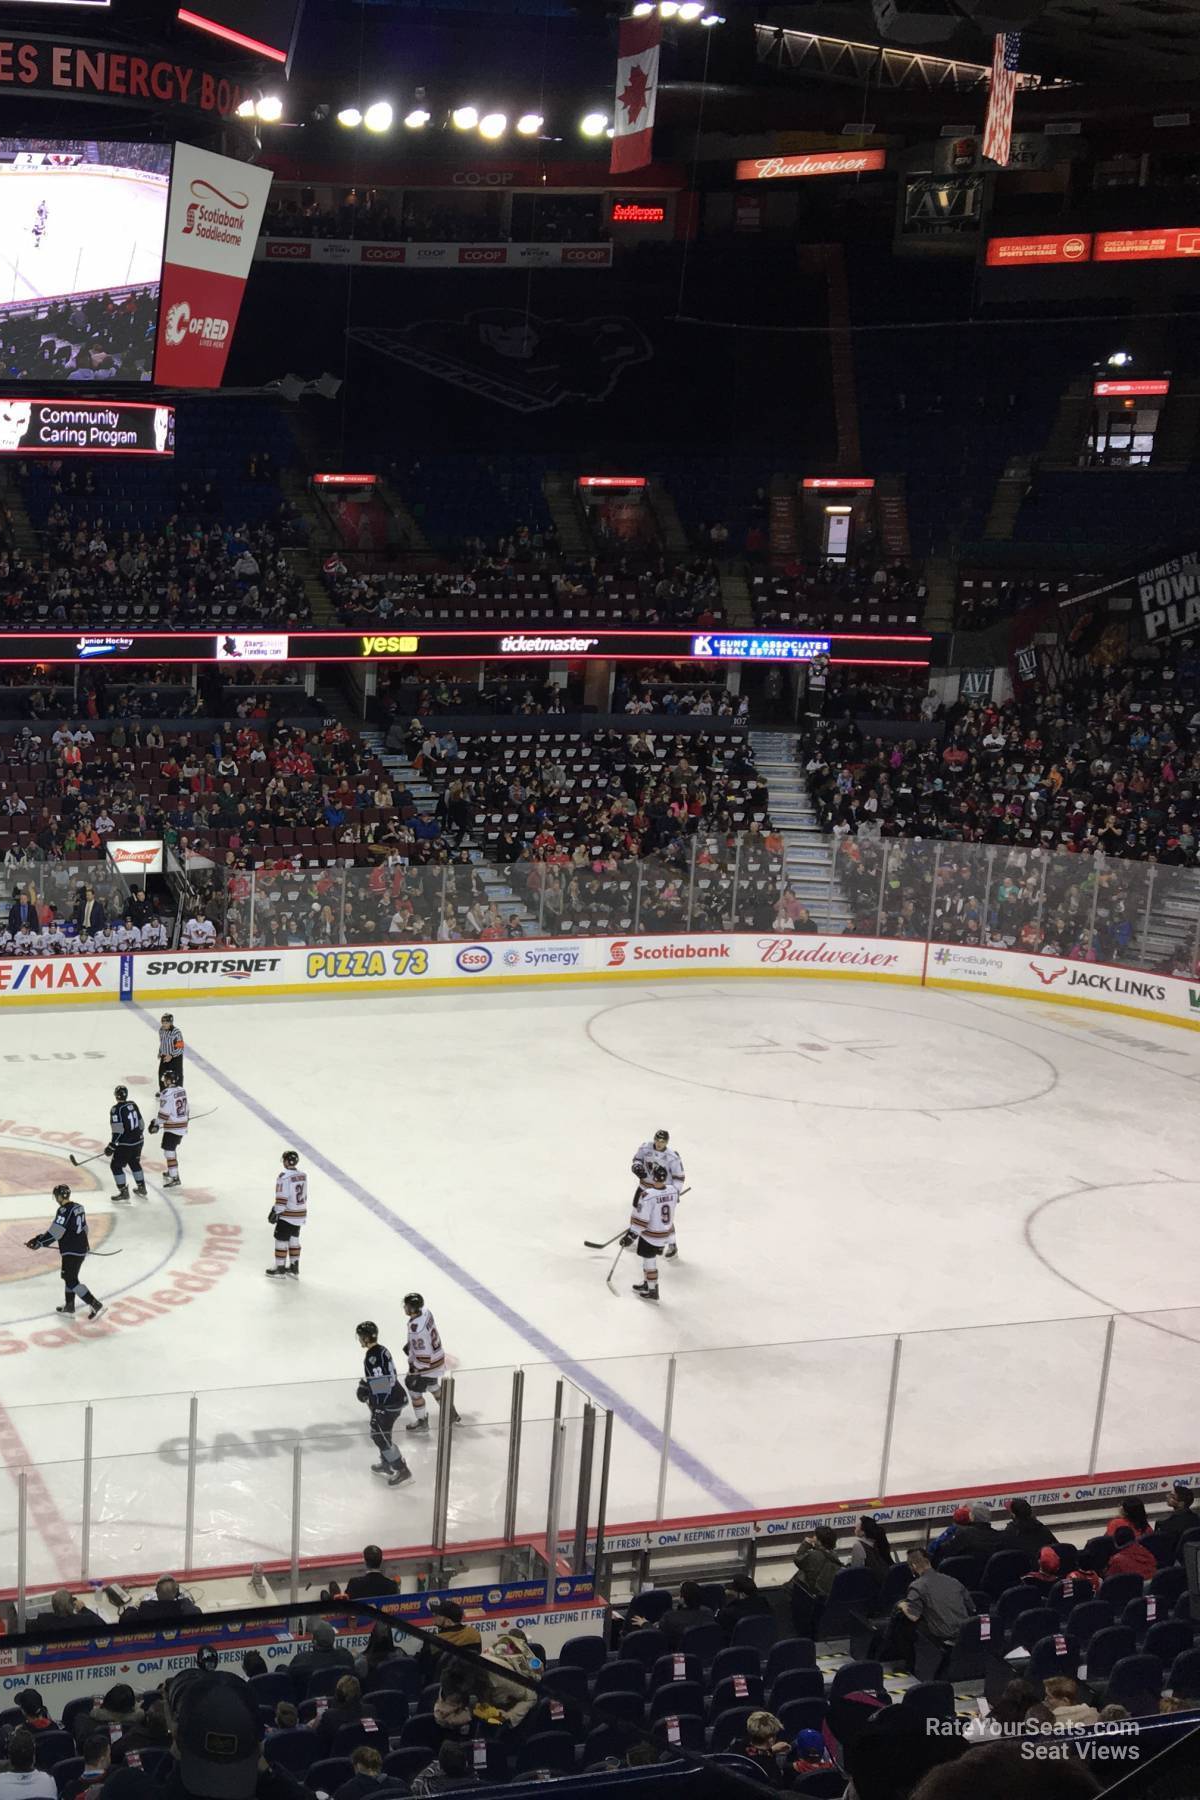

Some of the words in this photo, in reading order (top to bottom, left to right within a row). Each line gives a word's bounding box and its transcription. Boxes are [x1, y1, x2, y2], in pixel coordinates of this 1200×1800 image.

[52, 47, 194, 103] ENERGY
[26, 155, 33, 163] 2
[754, 155, 869, 179] Budweiser
[198, 204, 245, 231] Scotiabank
[614, 205, 665, 216] Saddleroom
[195, 221, 242, 247] Saddledome
[189, 317, 203, 335] OF
[202, 316, 230, 341] RED
[40, 407, 120, 428] Community
[40, 427, 87, 446] Caring
[90, 428, 138, 447] Program
[77, 637, 105, 650] Junior
[105, 637, 134, 646] Hockey
[362, 636, 400, 656] yes
[501, 635, 594, 652] ticketmaster
[714, 640, 748, 648] LEUNG
[751, 640, 758, 648] &
[764, 640, 829, 650] ASSOCIATES
[749, 648, 789, 656] ESTATE
[961, 673, 991, 694] AVI
[114, 848, 159, 861] Budweiser
[461, 951, 488, 966] Esso
[525, 949, 580, 967] Synergy
[632, 944, 730, 961] Scotiabank
[755, 938, 899, 967] Budweiser
[145, 958, 281, 977] SPORTSNET
[306, 950, 387, 979] PIZZA
[392, 948, 429, 976] 73
[1067, 969, 1113, 992] JACK
[1114, 976, 1167, 1001] LINK'S
[661, 1204, 670, 1225] 9
[1075, 1488, 1096, 1500] OPA!
[1098, 1484, 1128, 1497] KEEPING
[1129, 1483, 1136, 1493] IT
[1137, 1481, 1158, 1493] FRESH
[658, 1533, 679, 1546] OPA!
[683, 1529, 716, 1543] KEEPING
[717, 1528, 724, 1539] IT
[725, 1526, 751, 1538] FRESH
[2, 1675, 31, 1690] OPA!
[34, 1671, 75, 1686] KEEPING
[76, 1669, 85, 1682] IT
[87, 1665, 117, 1679] FRESH
